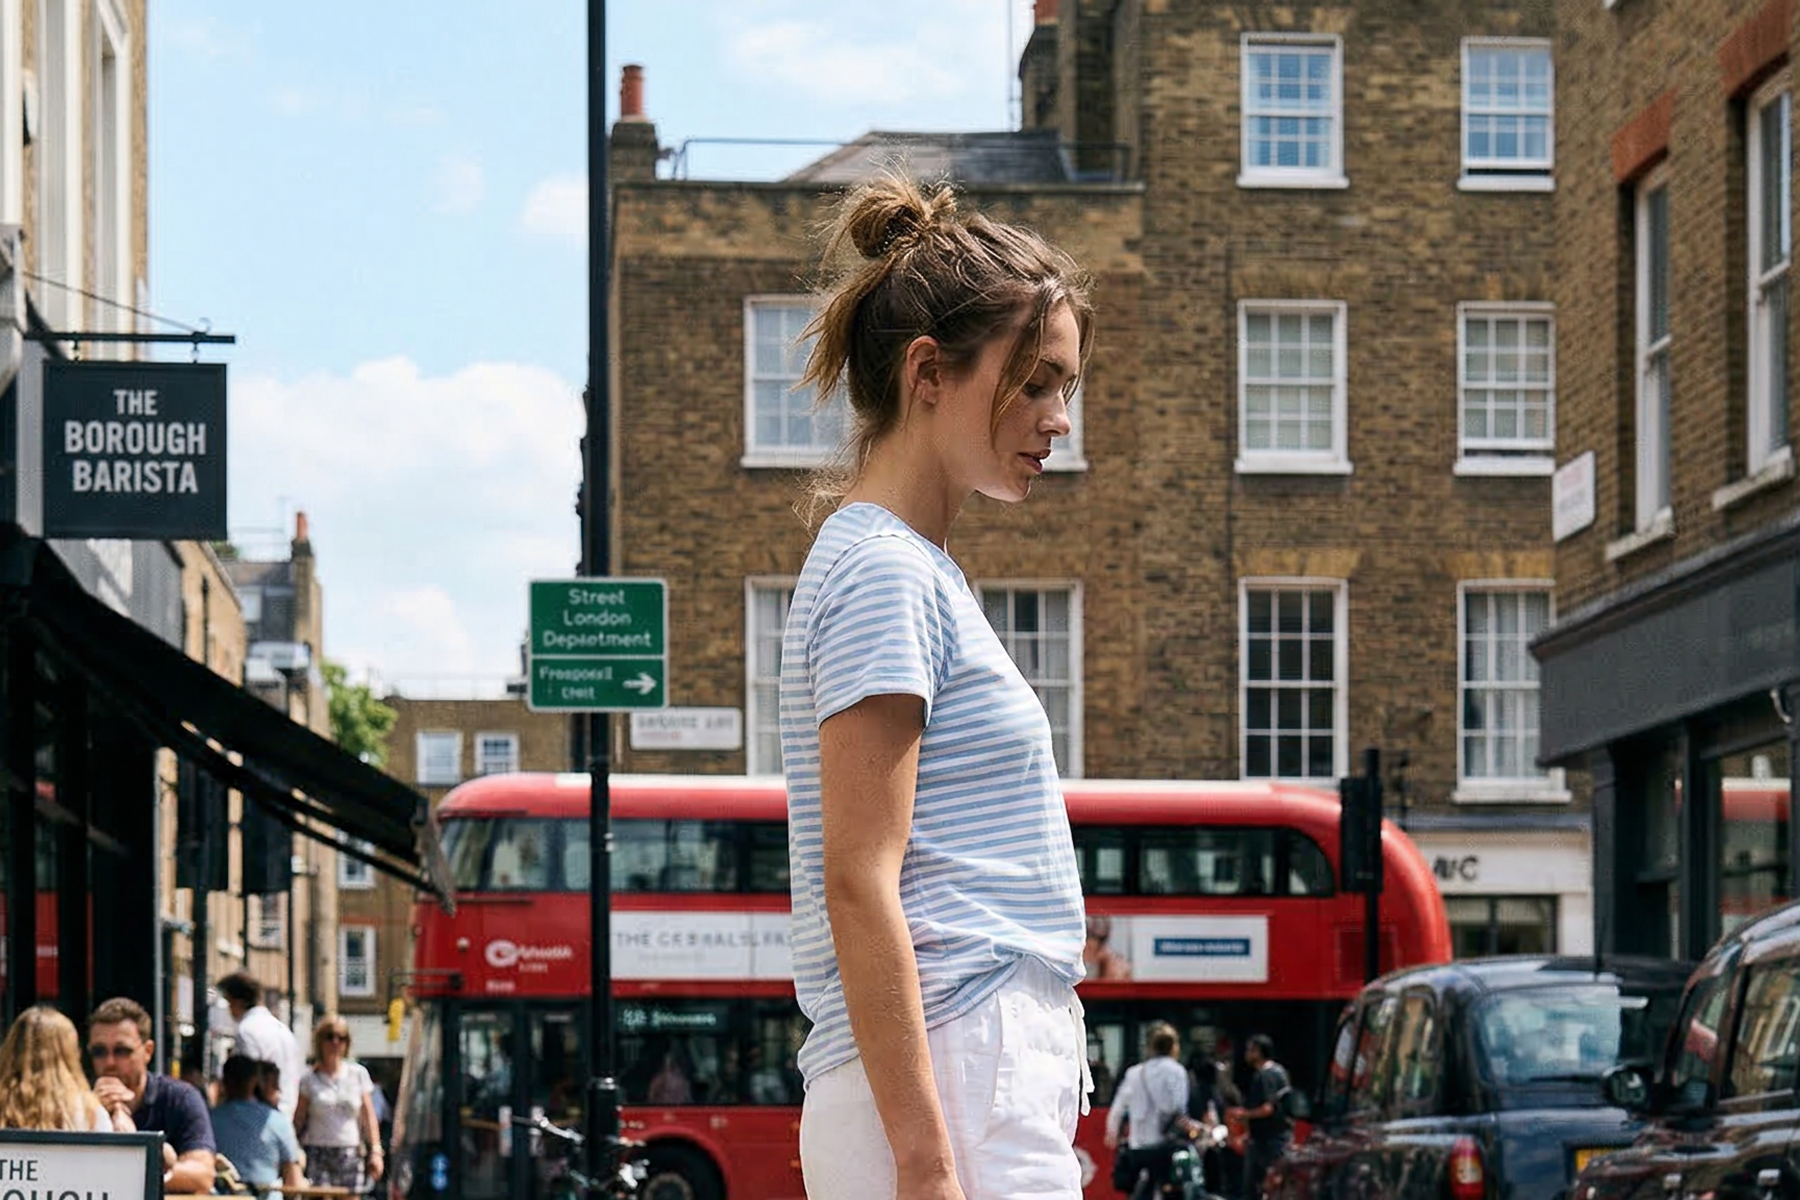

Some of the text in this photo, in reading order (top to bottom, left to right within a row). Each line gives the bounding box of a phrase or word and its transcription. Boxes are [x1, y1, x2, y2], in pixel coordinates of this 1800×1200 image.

[113, 389, 158, 416] THE
[64, 420, 207, 456] BOROUGH
[72, 459, 199, 494] BARISTA
[568, 587, 626, 605] Street
[562, 608, 632, 627] London
